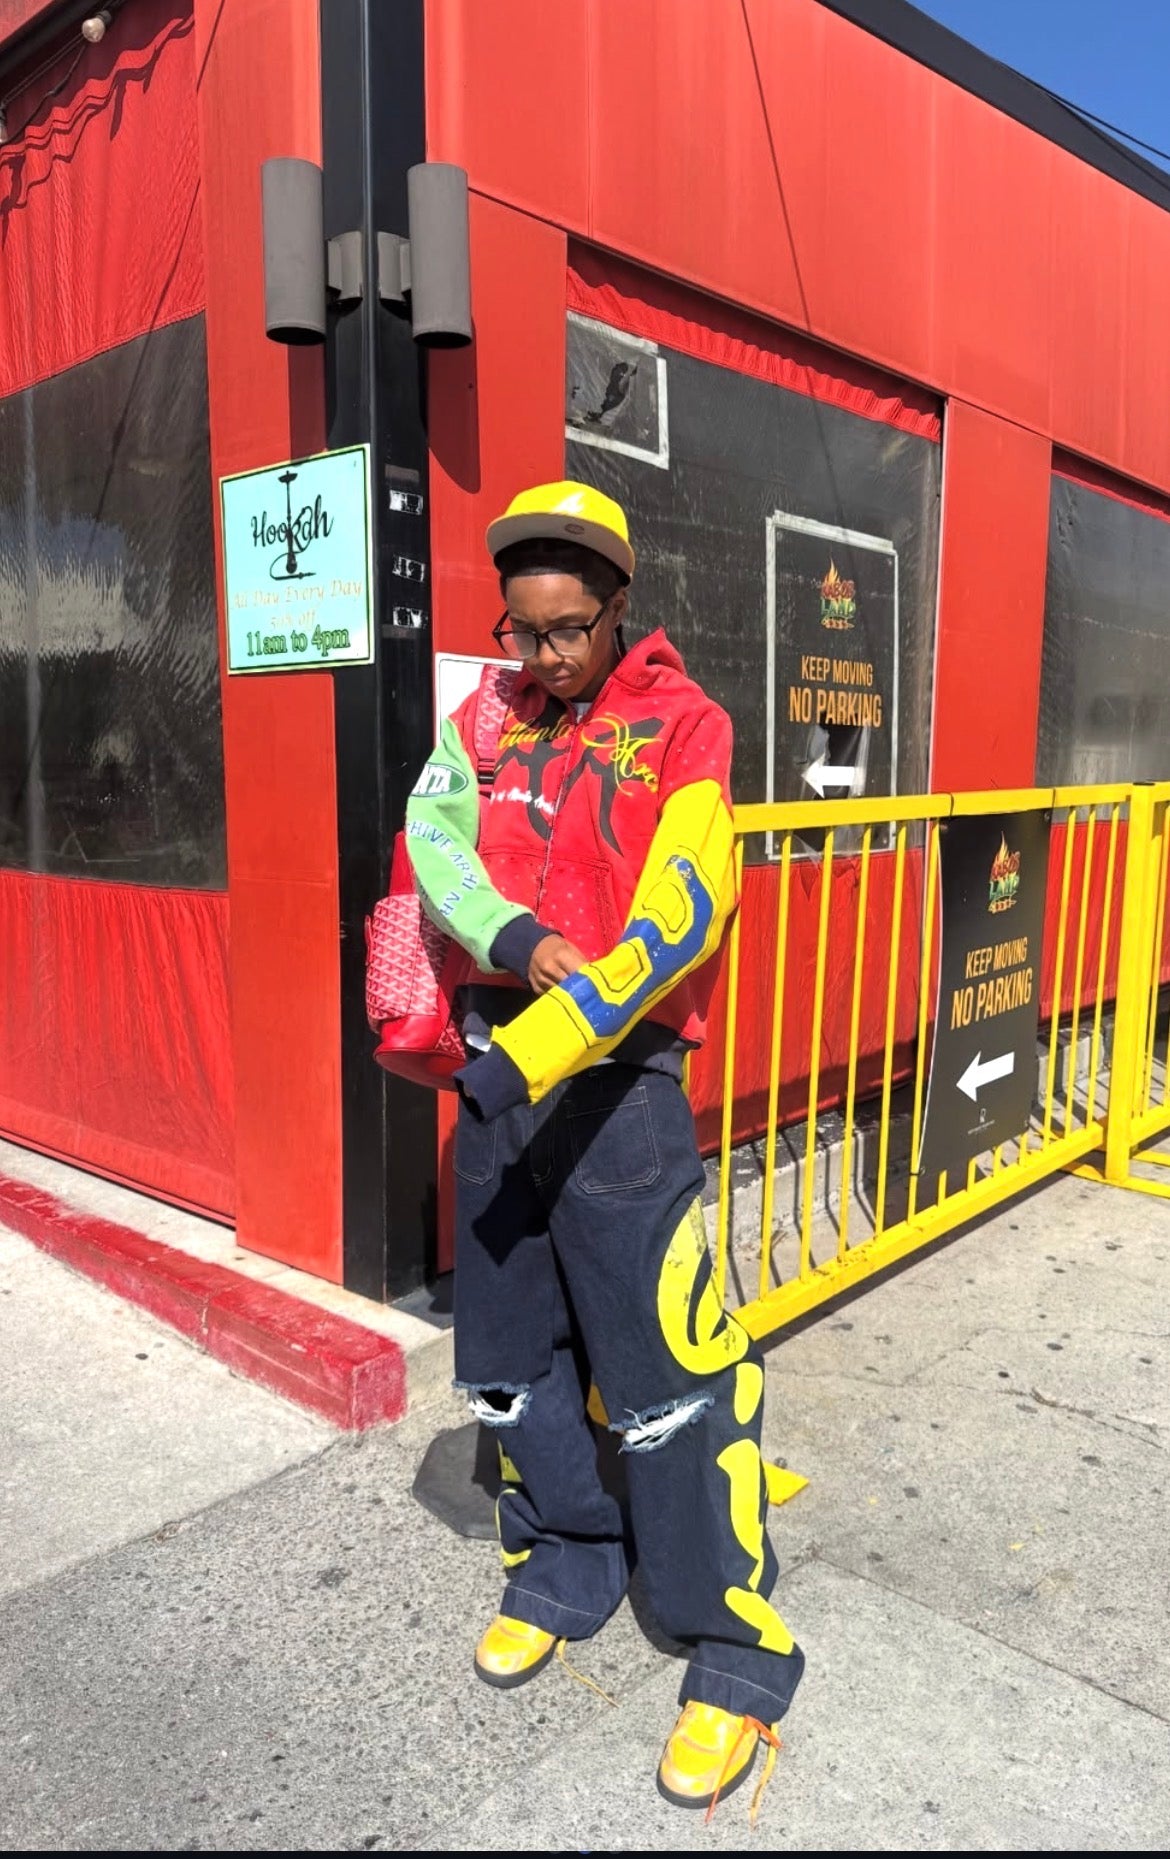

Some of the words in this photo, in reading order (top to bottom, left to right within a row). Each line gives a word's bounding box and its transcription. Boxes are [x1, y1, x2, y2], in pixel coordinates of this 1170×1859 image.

[250, 494, 334, 552] Hookah
[285, 586, 325, 607] Every
[330, 579, 363, 601] Day
[246, 630, 288, 657] 11am
[290, 629, 308, 653] to
[311, 624, 351, 657] 4pm
[801, 655, 831, 682] KEEP
[833, 659, 873, 687] MOVING
[789, 686, 812, 724] NO
[816, 689, 882, 728] PARKING
[965, 947, 993, 979] KEEP
[993, 936, 1028, 971] MOVING
[951, 986, 974, 1030] NO
[975, 967, 1033, 1022] PARKING
